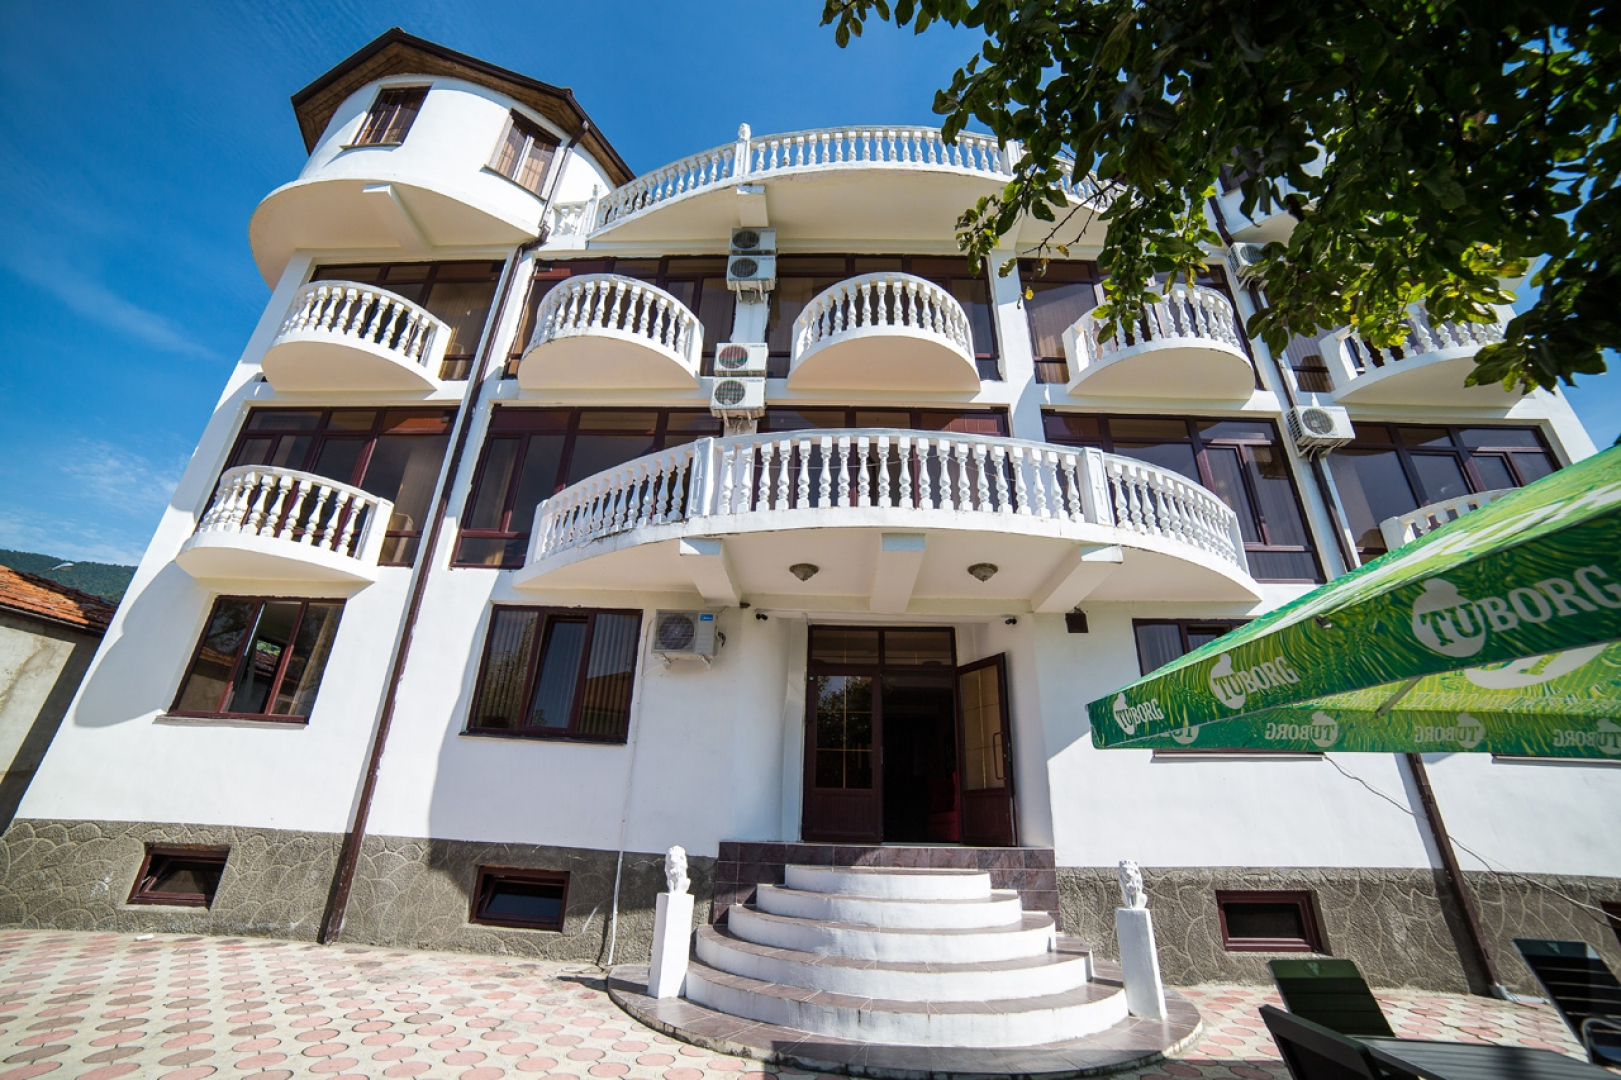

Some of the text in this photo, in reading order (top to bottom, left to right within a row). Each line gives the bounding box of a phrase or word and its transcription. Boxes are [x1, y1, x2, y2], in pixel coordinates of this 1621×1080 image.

[1419, 564, 1621, 647] TUBORG
[1213, 656, 1300, 701] TUBORG
[1115, 698, 1164, 729] TUBORG
